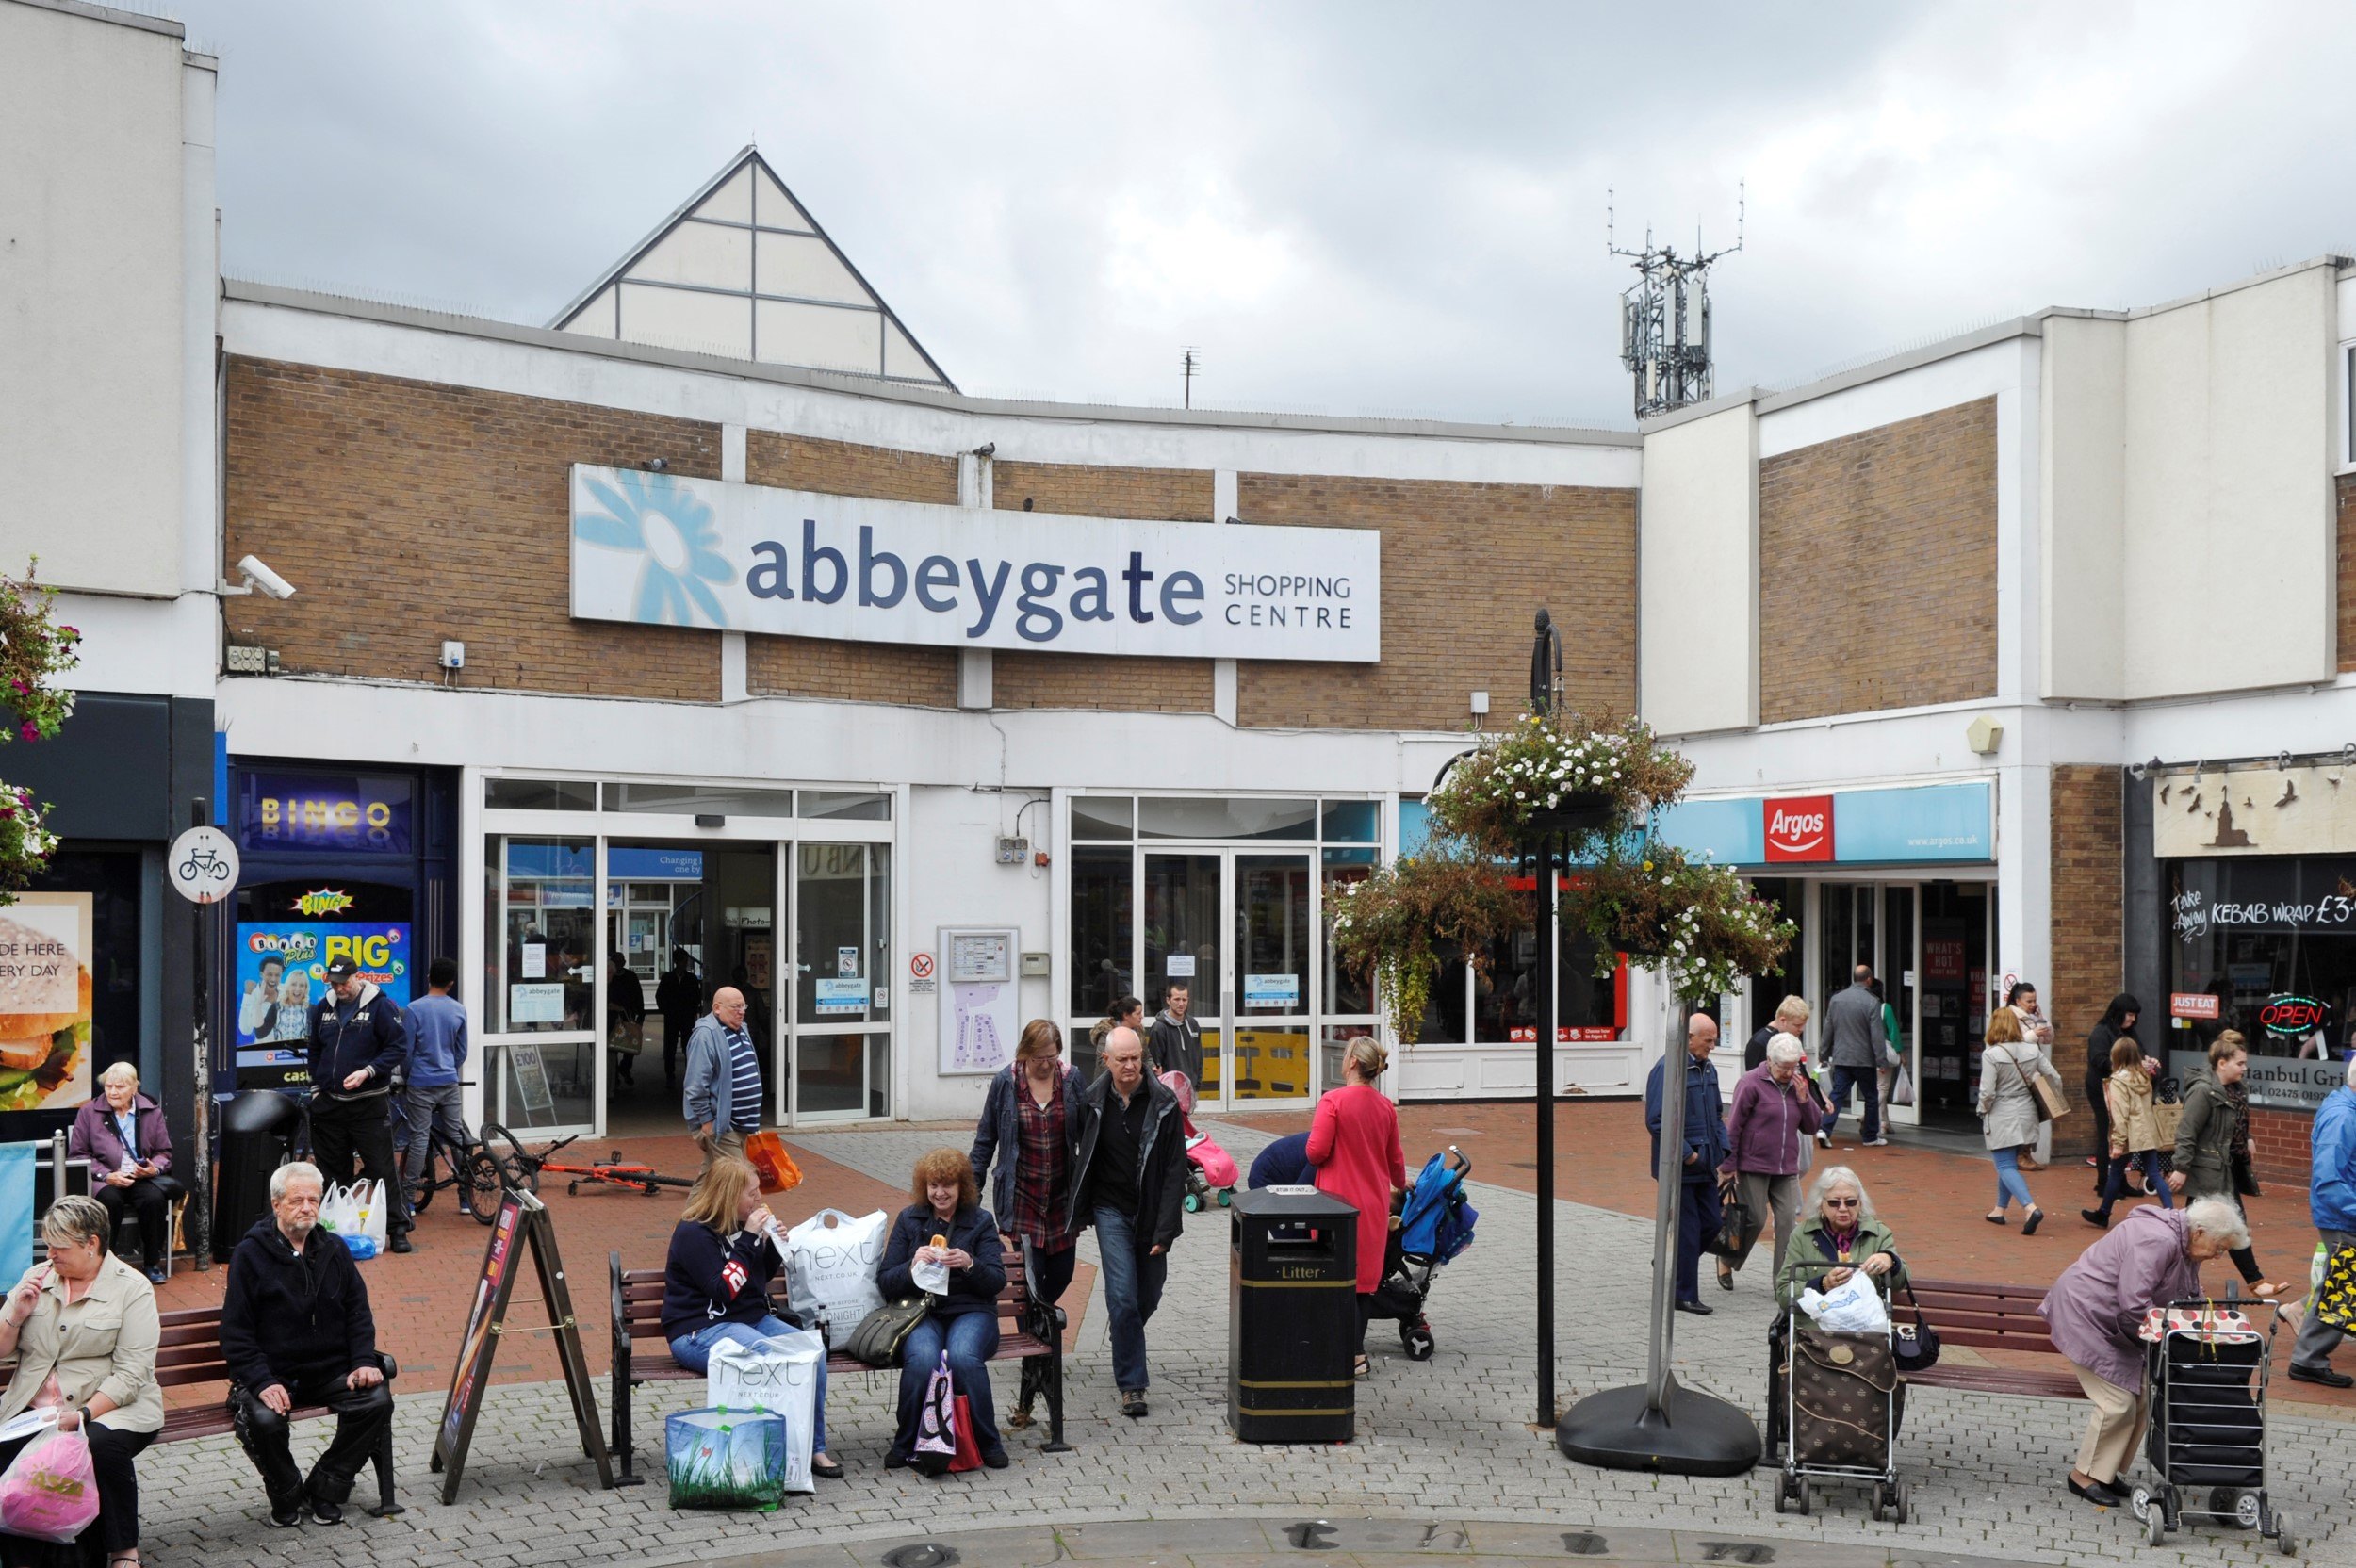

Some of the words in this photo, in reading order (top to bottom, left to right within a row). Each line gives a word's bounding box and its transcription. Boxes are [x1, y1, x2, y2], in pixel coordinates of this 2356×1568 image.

[746, 518, 1205, 642] abbeygate
[1224, 573, 1351, 599] SHOPPING
[1225, 603, 1351, 629] CENTRE
[262, 798, 390, 827] BINGO
[1769, 808, 1824, 841] Argos
[1907, 834, 1978, 848] www.argos.co.uk
[659, 856, 697, 865] Changing
[691, 865, 701, 874] by
[301, 894, 353, 916] BINGO
[2170, 890, 2201, 913] Take
[2212, 903, 2269, 923] KEBAB
[2272, 902, 2314, 927] WRAP
[2316, 895, 2356, 923] £3.
[2173, 908, 2208, 936] Away
[26, 943, 65, 956] HERE
[258, 939, 315, 950] BINGO
[325, 935, 390, 967] BIG
[1925, 942, 1962, 955] WHAT'S
[284, 948, 316, 966] Plus
[1935, 956, 1953, 967] HOT
[31, 965, 60, 977] DAY
[2173, 996, 2197, 1007] JUST
[2198, 997, 2217, 1008] EAT
[2259, 1005, 2323, 1025] OPEN
[515, 1052, 536, 1067] £100
[2244, 1065, 2307, 1085] tanbul
[790, 1241, 875, 1274] next
[1282, 1266, 1320, 1279] Litter
[826, 1308, 861, 1321] DNIGHT
[719, 1360, 802, 1386] next
